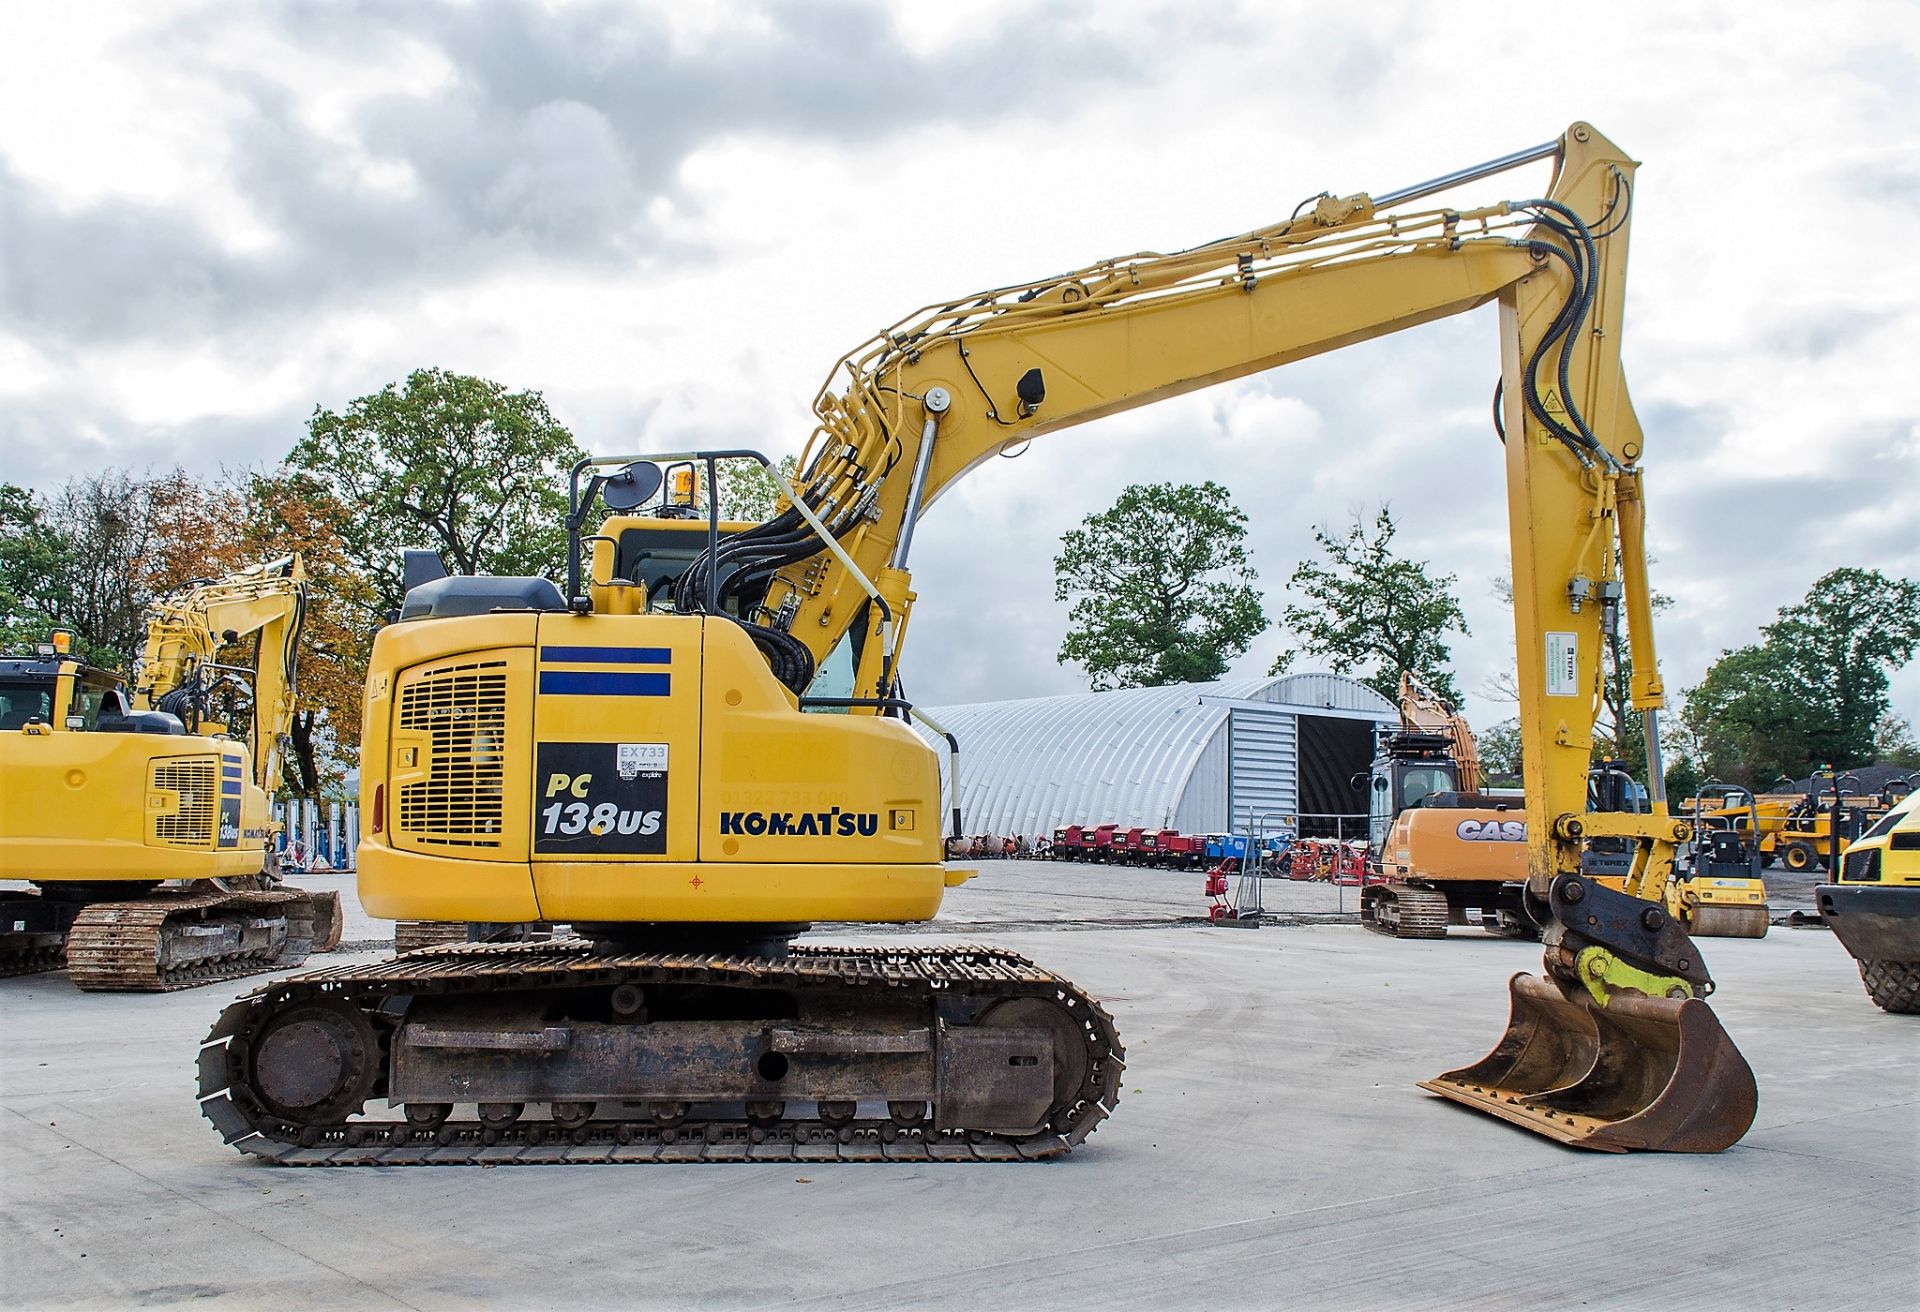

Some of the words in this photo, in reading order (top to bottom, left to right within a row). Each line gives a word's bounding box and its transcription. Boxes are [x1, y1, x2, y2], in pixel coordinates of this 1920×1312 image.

[621, 747, 665, 757] EX733
[545, 774, 592, 798] PC
[541, 803, 661, 836] 138US
[720, 806, 878, 836] KOMATSU
